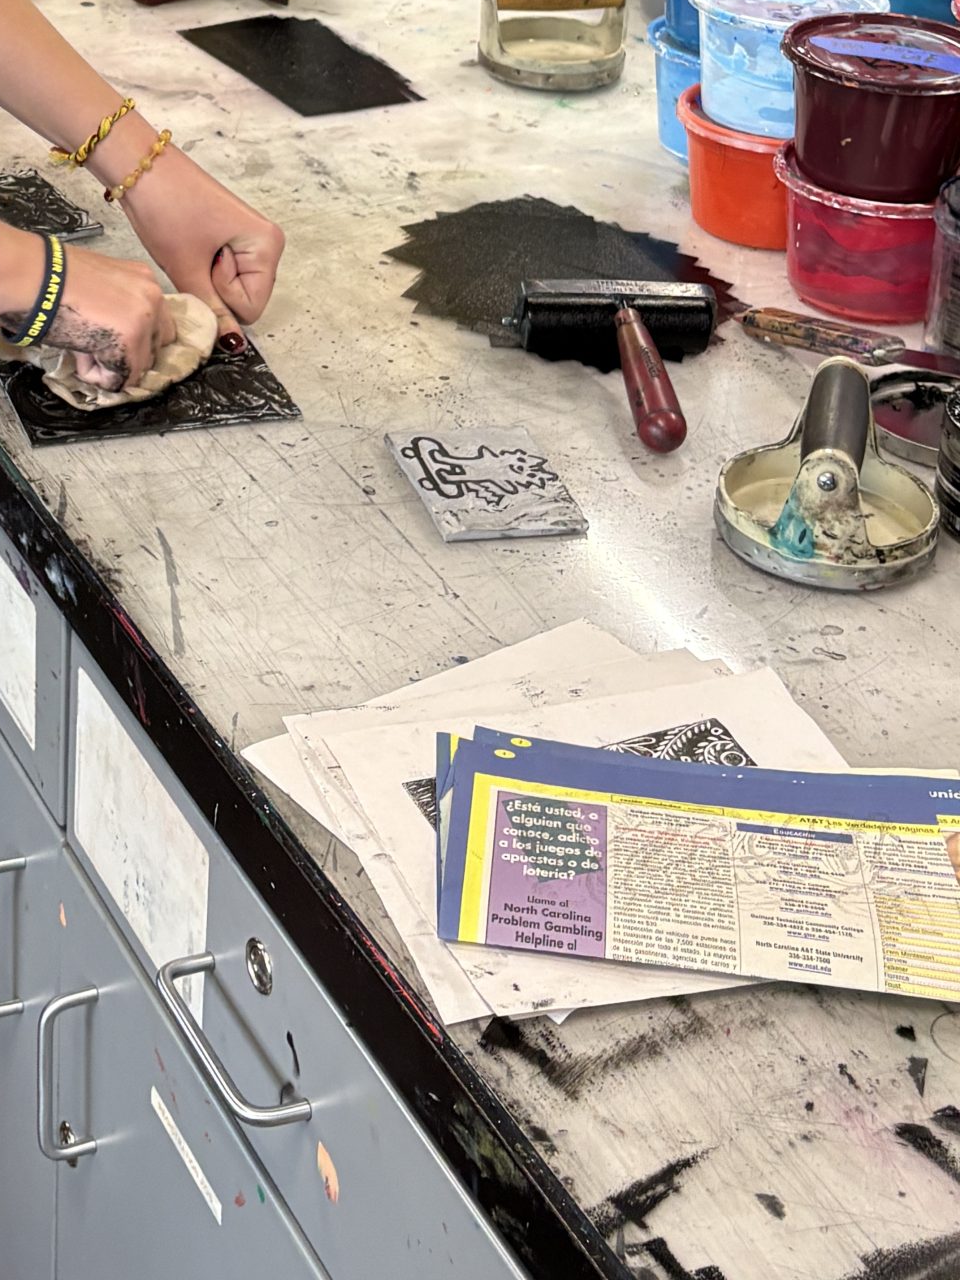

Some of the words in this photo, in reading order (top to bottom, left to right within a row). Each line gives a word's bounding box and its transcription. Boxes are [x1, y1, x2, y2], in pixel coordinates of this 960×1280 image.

[41, 274, 61, 311] ARTS
[27, 312, 47, 337] AND
[506, 800, 541, 813] ¿Está
[545, 806, 586, 820] usted,
[511, 814, 562, 829] alguien
[566, 823, 592, 833] que
[503, 826, 554, 841] conoce,
[557, 832, 600, 846] adicto
[498, 839, 509, 848] a
[512, 838, 532, 851] los
[535, 841, 581, 857] juegos
[584, 846, 602, 858] de
[501, 852, 564, 867] apuestas
[567, 859, 577, 868] o
[581, 858, 599, 870] de
[527, 895, 556, 907] Llame
[559, 899, 569, 908] al
[503, 902, 538, 916] North
[541, 908, 592, 923] Carolina
[491, 913, 540, 930] Problem
[544, 921, 603, 941] Gambling
[515, 931, 564, 949] Helpline
[567, 939, 577, 951] al
[755, 940, 773, 948] North
[773, 942, 799, 952] Carolina
[800, 946, 813, 954] A&T
[815, 948, 831, 956] State
[832, 951, 864, 963] University
